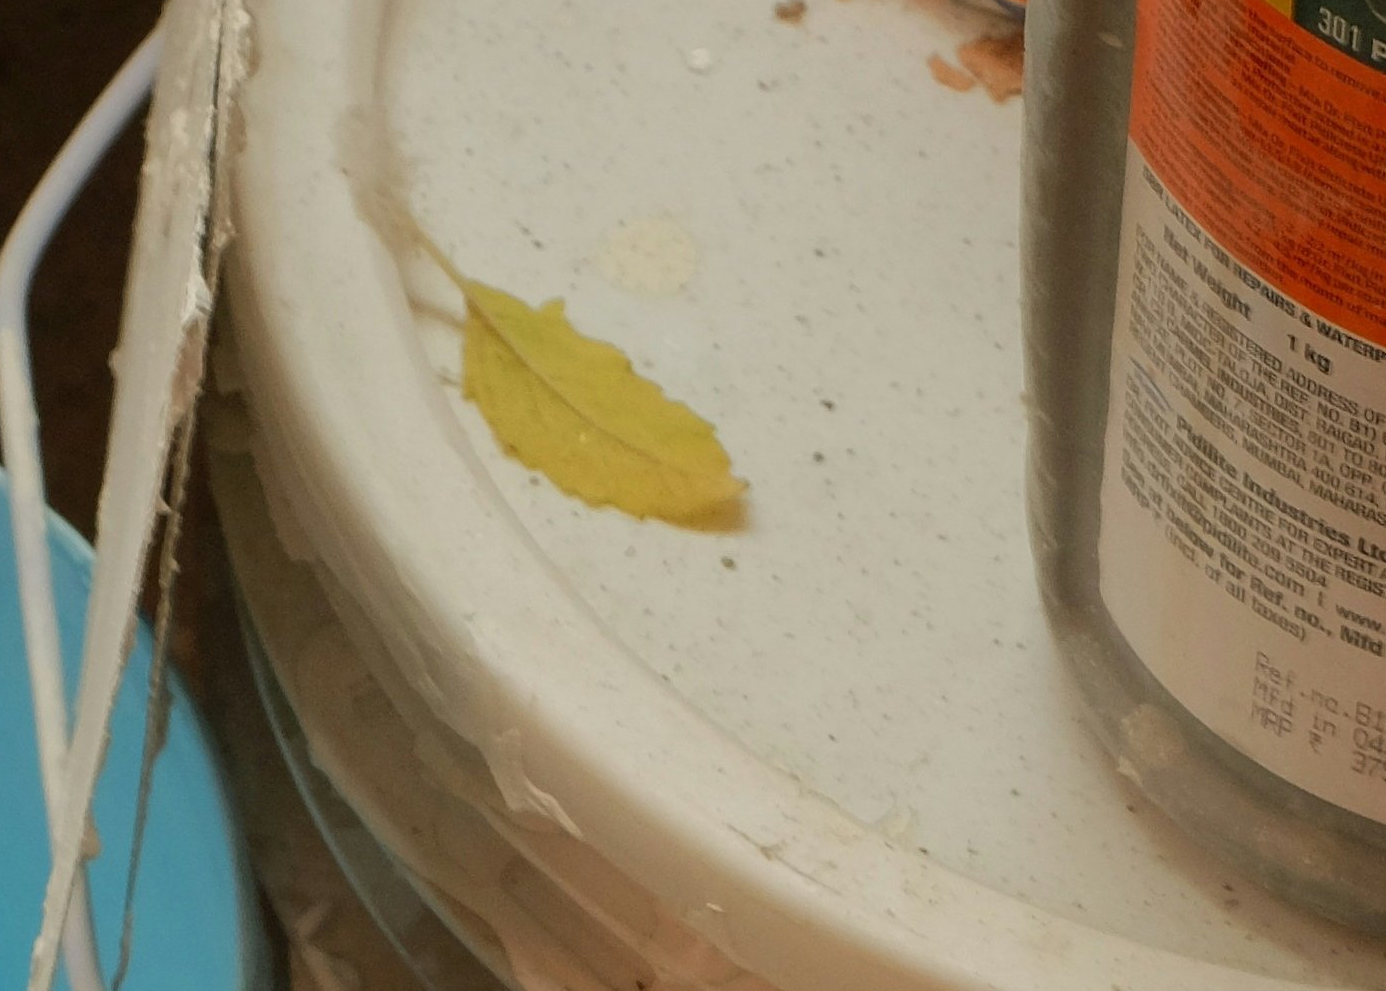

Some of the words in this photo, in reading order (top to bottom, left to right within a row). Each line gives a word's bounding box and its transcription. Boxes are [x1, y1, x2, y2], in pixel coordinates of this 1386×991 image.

[1317, 7, 1361, 52] 301
[1234, 262, 1297, 317] REPAIRS
[1299, 312, 1312, 329] &
[1287, 333, 1297, 352] 1
[1303, 342, 1334, 376] kg
[1286, 368, 1359, 416] ADDRESS
[1316, 401, 1343, 426] NO.
[1343, 447, 1365, 468] TO
[1241, 471, 1351, 547] Industries
[1275, 534, 1294, 553] AT
[1301, 547, 1332, 574] THE
[1277, 516, 1310, 544] FOR
[1312, 536, 1376, 576] EXPERT
[1339, 624, 1384, 658] Mfd
